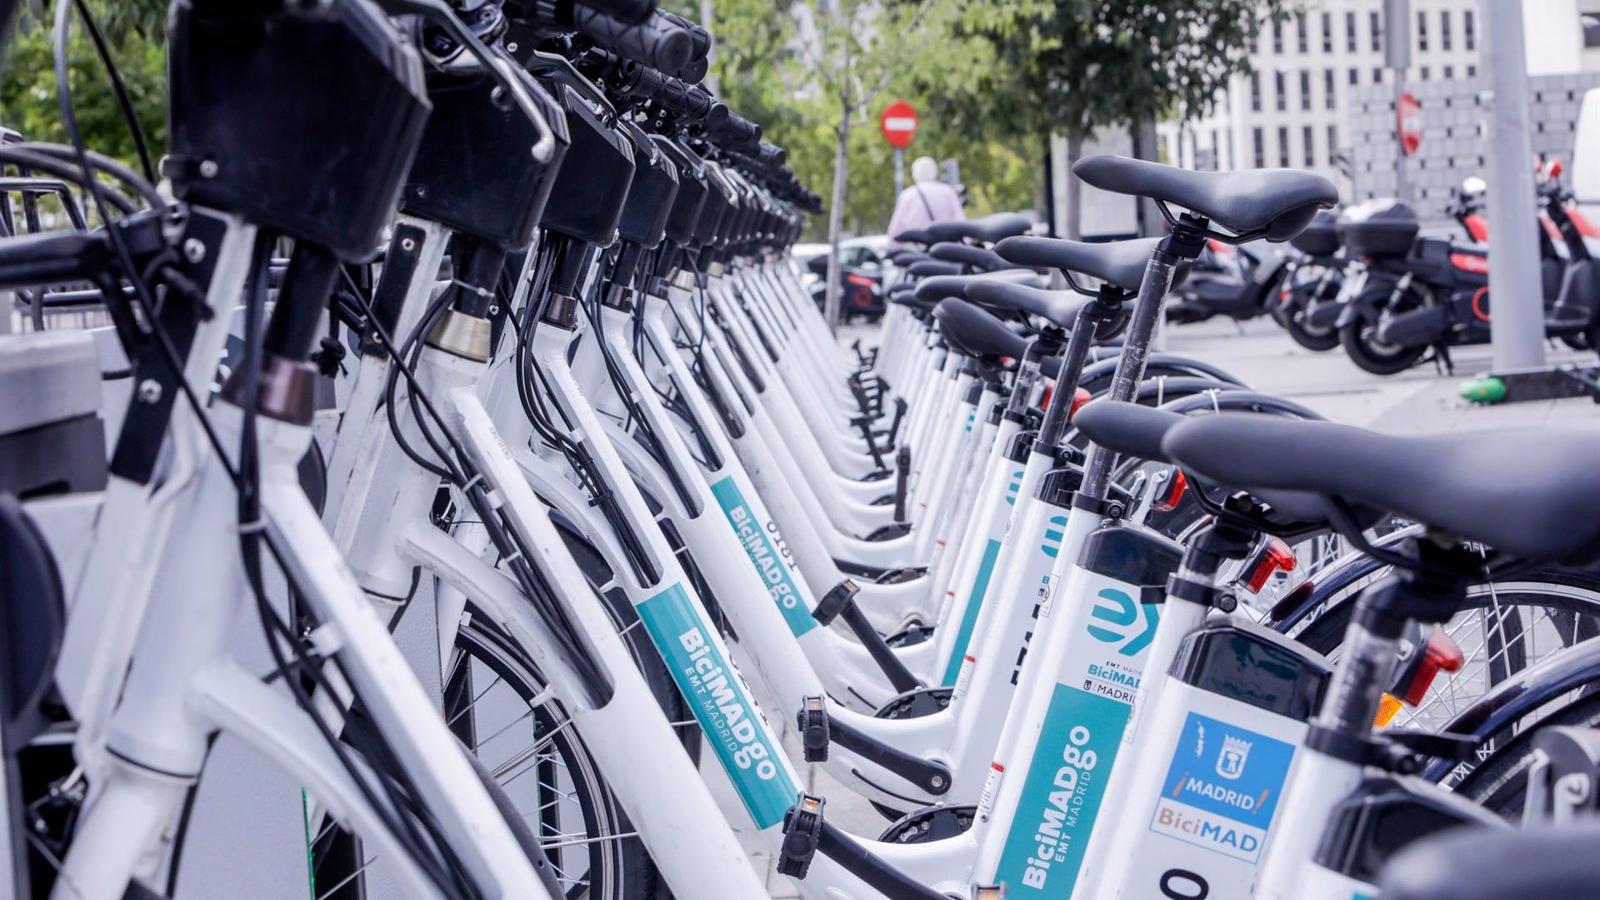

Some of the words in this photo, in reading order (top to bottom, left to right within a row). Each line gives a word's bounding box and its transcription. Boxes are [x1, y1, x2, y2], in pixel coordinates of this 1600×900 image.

[729, 505, 797, 609] BiciMADgo
[678, 627, 776, 780] BiciMADgo
[684, 666, 706, 696] EMT
[703, 700, 738, 752] MADRID
[1096, 684, 1136, 704] MADRI
[1021, 725, 1098, 891] BiciMADgo
[1055, 832, 1072, 863] EMT
[1066, 770, 1091, 827] MADRID
[1157, 807, 1258, 852] BiciMAD
